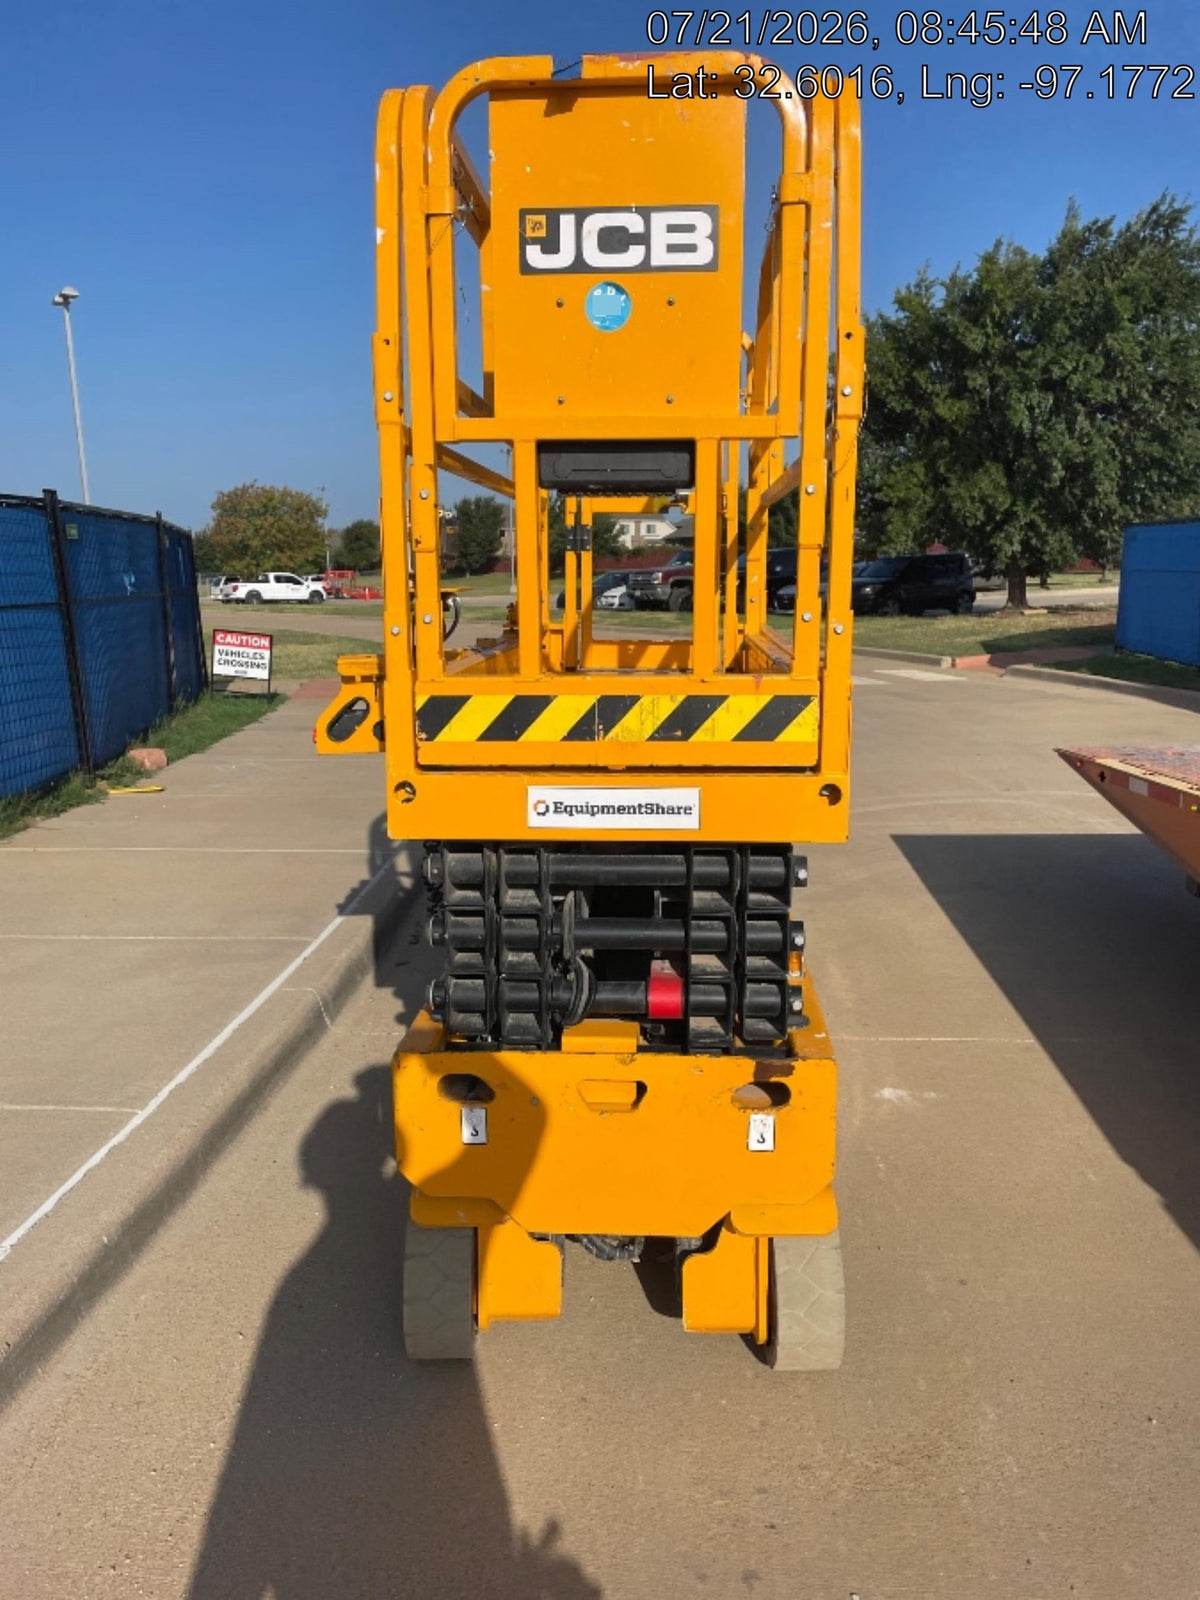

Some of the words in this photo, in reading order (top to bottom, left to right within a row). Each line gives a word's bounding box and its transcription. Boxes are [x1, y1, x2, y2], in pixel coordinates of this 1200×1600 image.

[525, 211, 714, 269] JCB
[216, 633, 270, 648] CAUTION
[217, 648, 265, 660] VEHICLES
[217, 658, 267, 671] CROSSING
[552, 801, 692, 817] EquipmentShare
